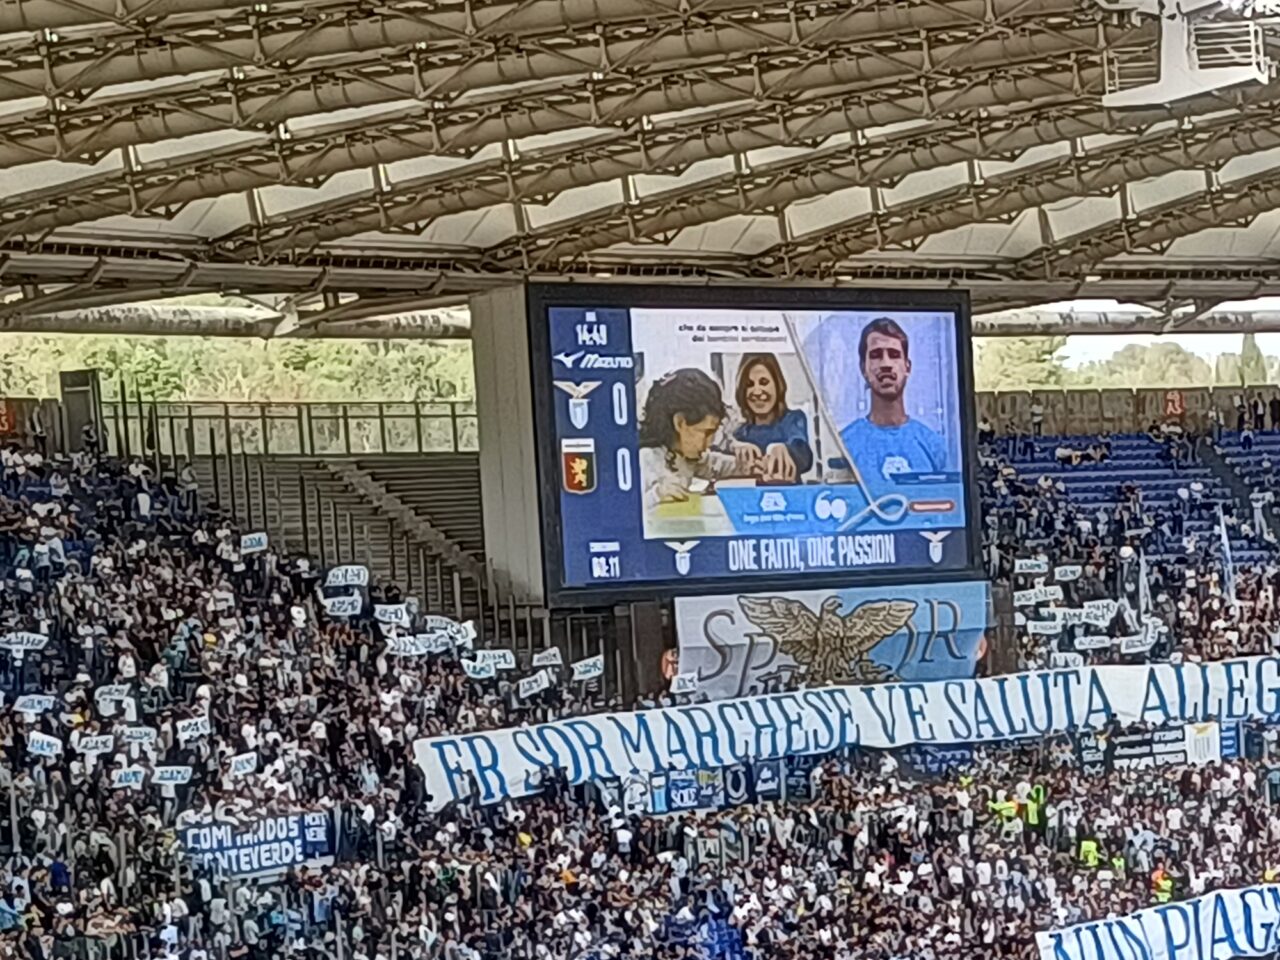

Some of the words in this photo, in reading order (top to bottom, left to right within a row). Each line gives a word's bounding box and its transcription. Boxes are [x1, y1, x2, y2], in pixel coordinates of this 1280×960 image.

[612, 382, 628, 426] 0
[616, 447, 632, 492] 0
[728, 540, 759, 572] ONE
[760, 537, 806, 572] FAITH,
[807, 536, 836, 568] ONE
[838, 533, 896, 566] PASSION
[698, 599, 967, 698] SPR
[513, 719, 615, 793] SOR
[607, 688, 860, 773] MARCHESE
[860, 683, 935, 744] VE
[943, 667, 1113, 740] SALUTA
[190, 840, 304, 873] ONTEVERDE
